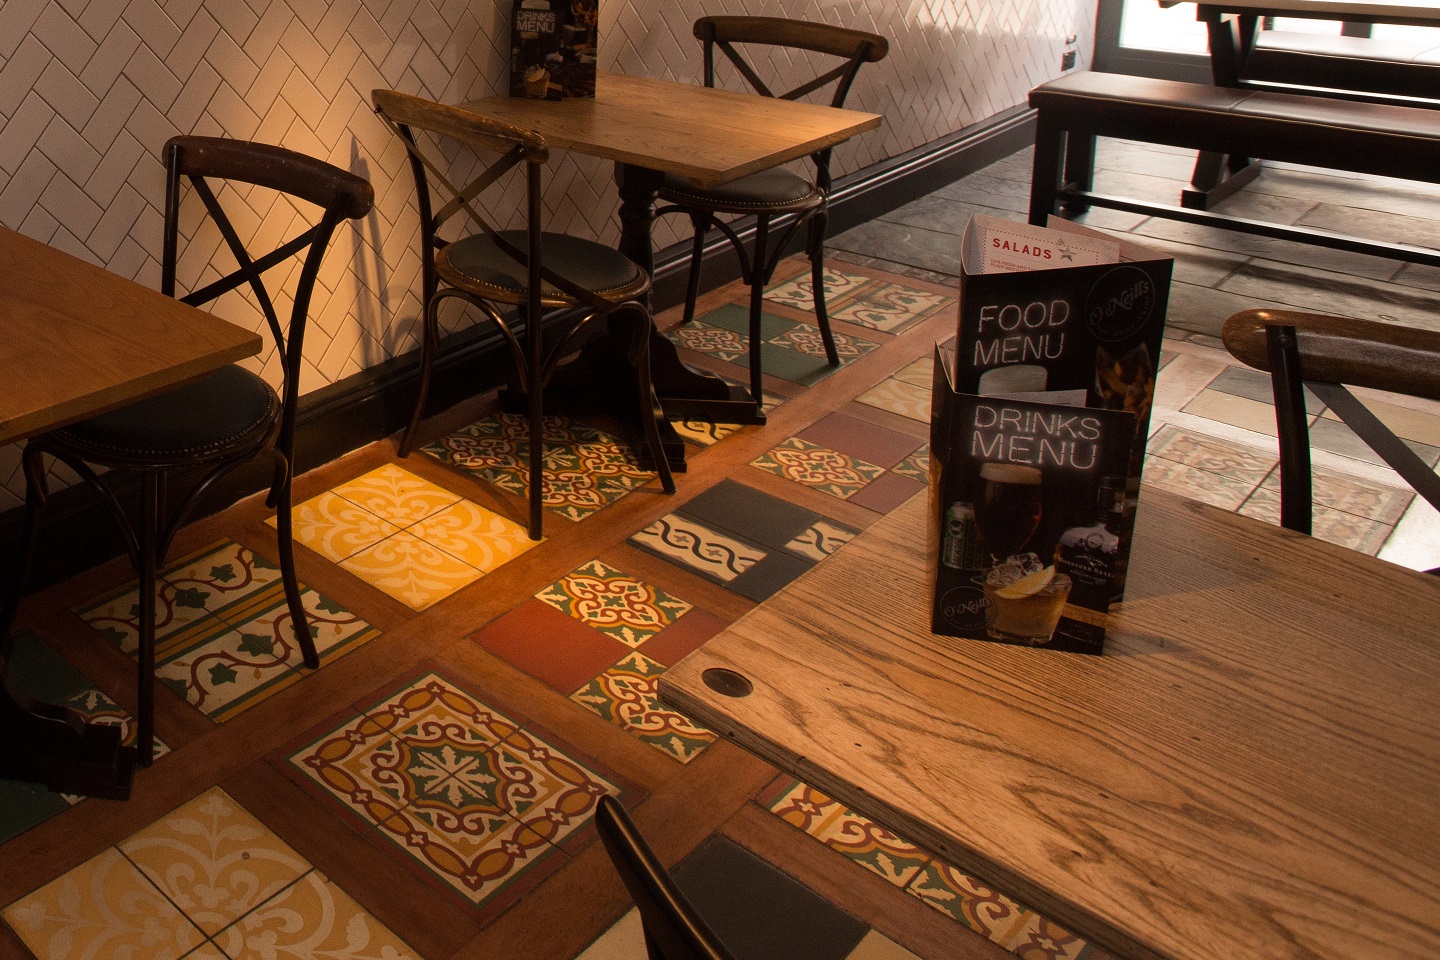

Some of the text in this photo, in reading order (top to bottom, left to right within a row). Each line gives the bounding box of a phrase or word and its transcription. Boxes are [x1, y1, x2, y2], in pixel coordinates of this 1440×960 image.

[516, 11, 556, 22] DRINKS
[516, 21, 555, 33] MENU
[993, 238, 1051, 259] SALADS
[978, 299, 1070, 333] FOOD
[973, 333, 1065, 367] MENU
[974, 405, 1102, 441] DRINKS
[970, 430, 1098, 470] MENU
